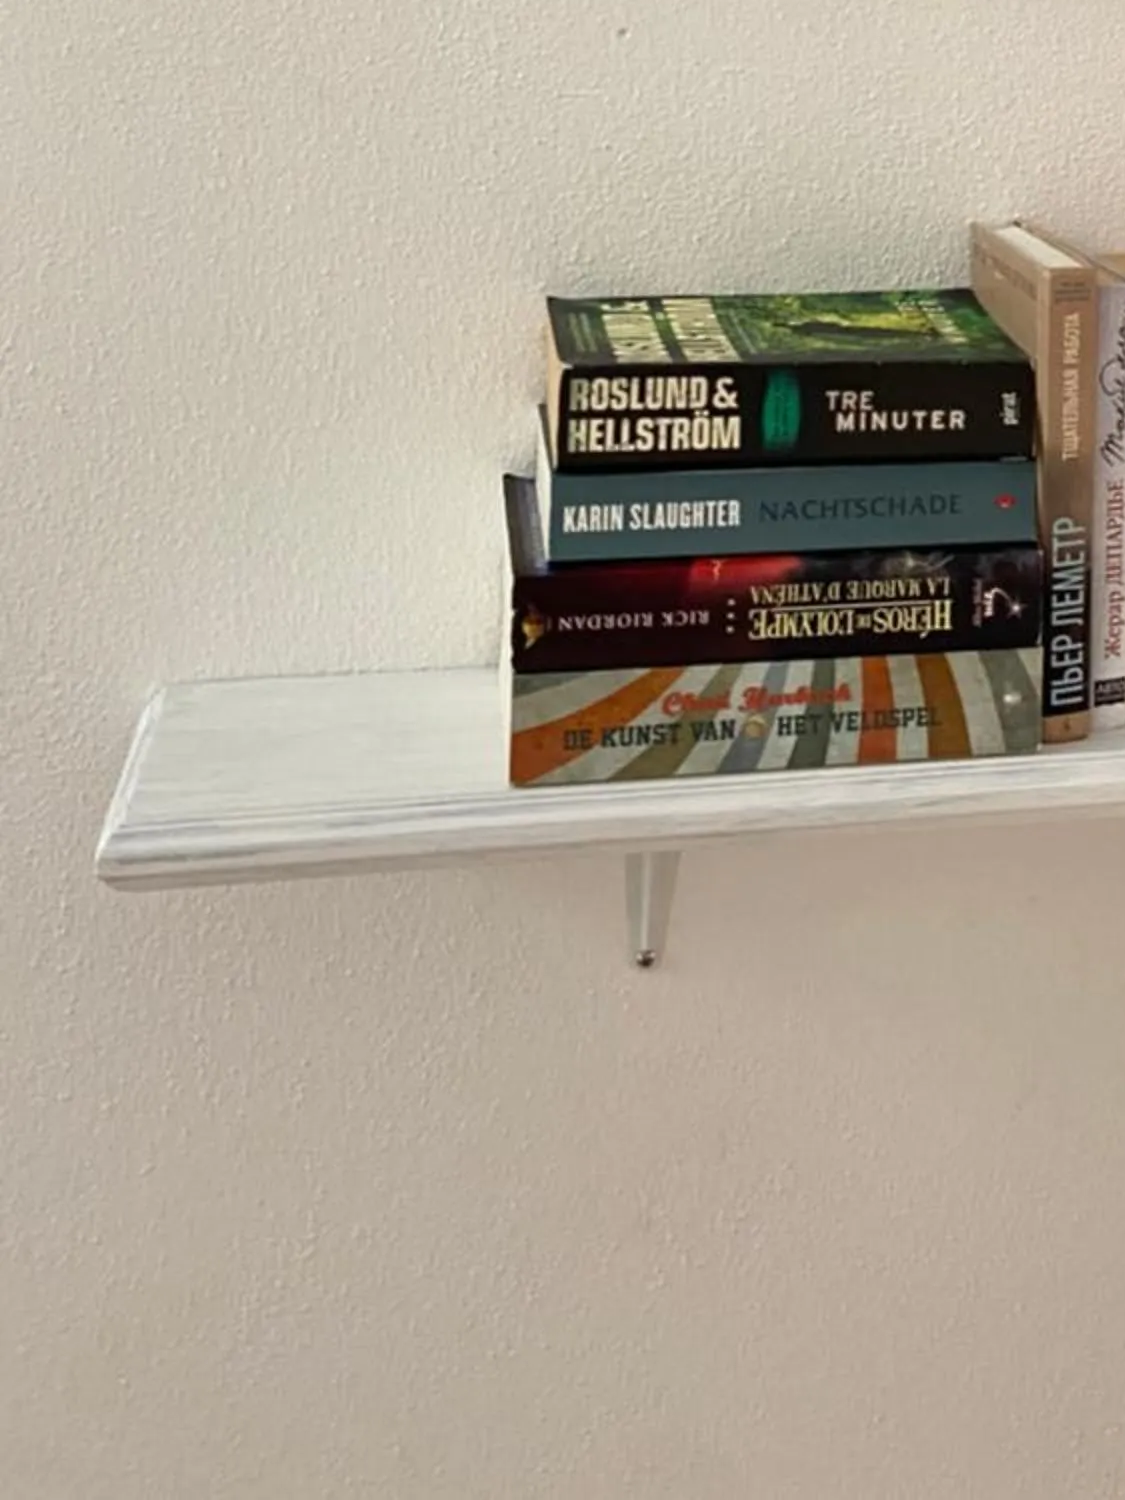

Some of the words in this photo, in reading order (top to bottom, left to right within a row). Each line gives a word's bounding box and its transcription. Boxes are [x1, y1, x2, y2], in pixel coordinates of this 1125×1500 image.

[1061, 313, 1080, 365] РАБОТА
[569, 376, 709, 411] ROSLUND
[712, 377, 738, 409] &
[825, 390, 875, 411] TRE
[567, 410, 742, 453] HELLSTRÖM
[836, 410, 967, 433] MINUTER
[562, 505, 624, 534] KARIN
[628, 499, 742, 530] SLAUGHTER
[758, 493, 962, 523] NACHTSCHADE
[1105, 479, 1125, 586] ДЕПАРДЬЕ
[926, 576, 950, 597] LA
[1051, 516, 1086, 626] ЛЕМЕТР
[846, 578, 922, 600] MARQUE
[558, 612, 654, 632] RIORDAN
[662, 610, 710, 627] RICK
[748, 608, 855, 641] L'OLYMPE
[873, 599, 953, 639] HÉROS
[1104, 590, 1125, 662] Жерар
[1050, 634, 1085, 707] ПЬЕР
[563, 729, 593, 750] DE
[601, 723, 681, 749] KUNST
[691, 720, 736, 741] VAN
[777, 712, 825, 737] HET
[831, 706, 944, 734] VELDSPEL
